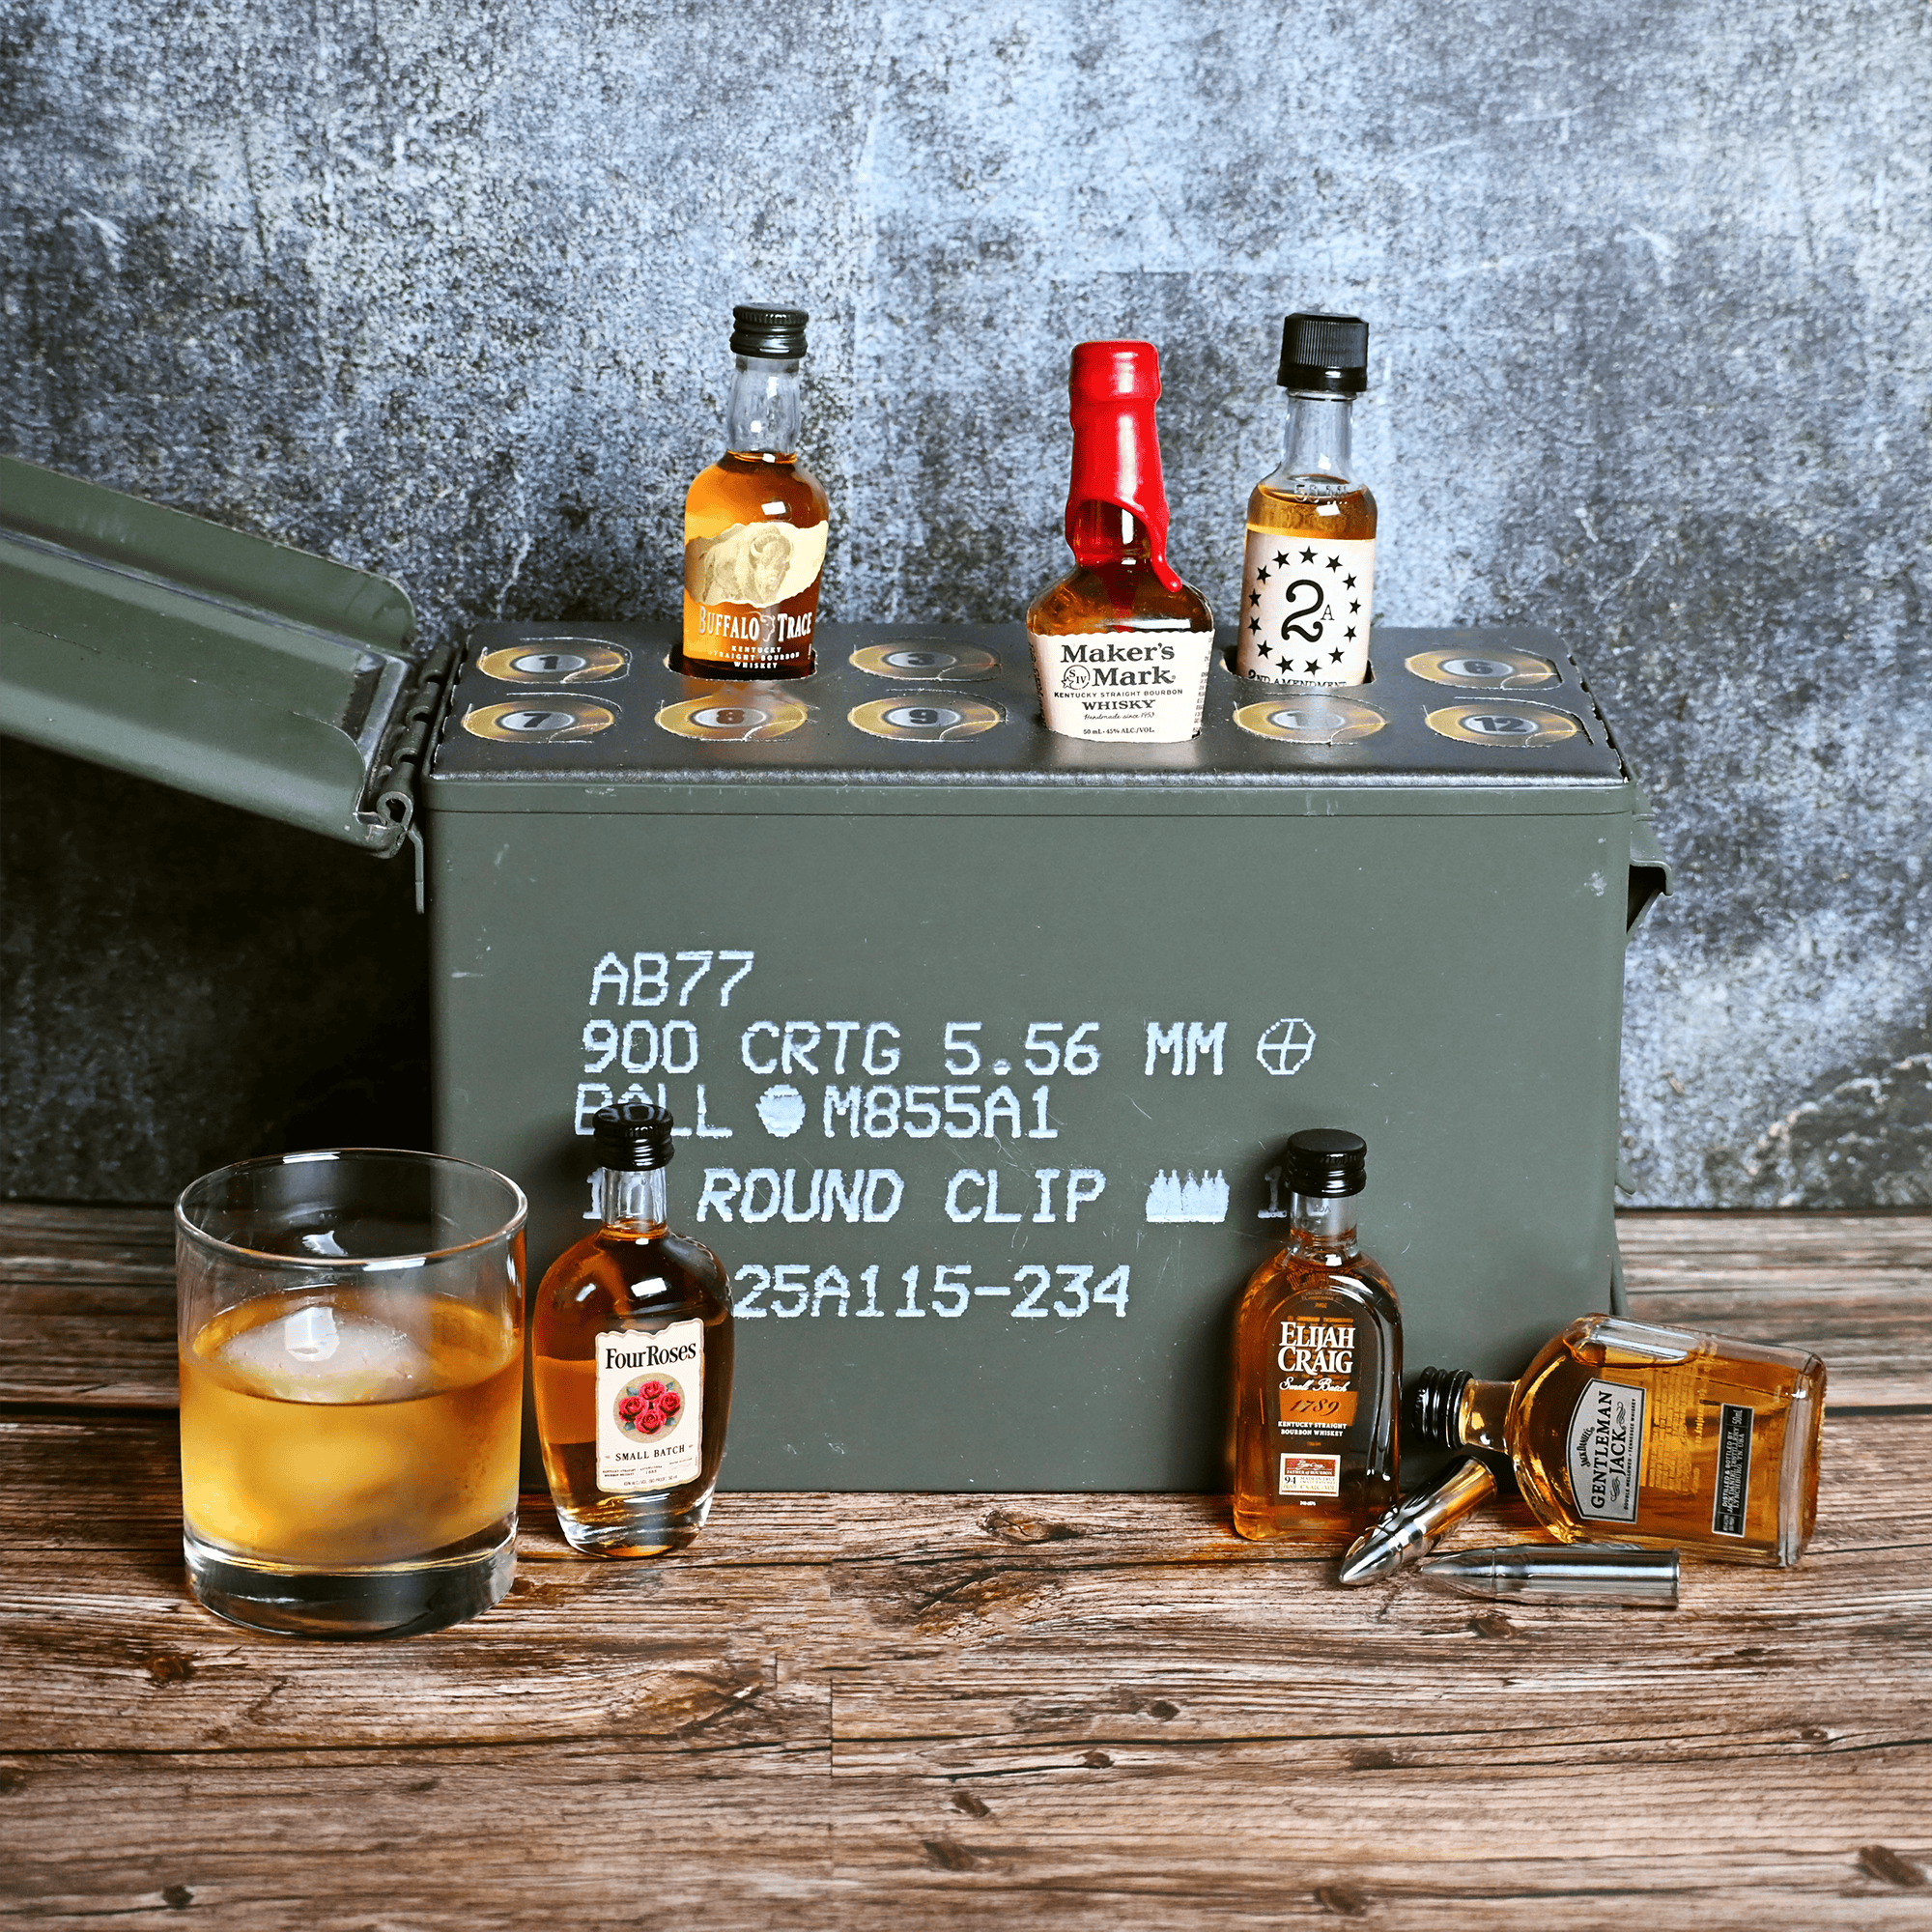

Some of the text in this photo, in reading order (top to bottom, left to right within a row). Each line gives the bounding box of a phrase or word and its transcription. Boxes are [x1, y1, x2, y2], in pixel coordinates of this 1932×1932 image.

[1281, 579, 1334, 642] 2 A
[699, 606, 812, 642] BUFFALO TRACE
[709, 650, 799, 661] STRAIGHT BOURBON
[908, 653, 935, 666] 3
[1060, 643, 1175, 663] Maker's
[539, 656, 559, 670] 1
[1462, 661, 1493, 675] 6
[1092, 666, 1174, 686] Mark
[1082, 699, 1156, 710] WHISKY
[522, 713, 551, 728] 7
[716, 709, 745, 724] 8
[909, 709, 938, 724] 9
[1473, 717, 1528, 732] 12
[589, 950, 755, 1007] AB77
[582, 1019, 1227, 1076] 900 CRTG 5.56 MM
[823, 1084, 1058, 1139] M855A1
[696, 1168, 905, 1223] ROUND
[944, 1169, 1107, 1223] CLIP
[1279, 1321, 1356, 1352] ELIJAH
[1278, 1346, 1353, 1376] CRAIG
[1279, 1376, 1351, 1392] Small Batch
[1290, 1398, 1341, 1416] 1789
[1727, 1431, 1733, 1440] BY
[615, 1444, 685, 1462] SMALL BATCH
[1579, 1450, 1591, 1467] JACK
[1591, 1391, 1612, 1509] GENTLEMAN
[1609, 1429, 1626, 1476] JACK
